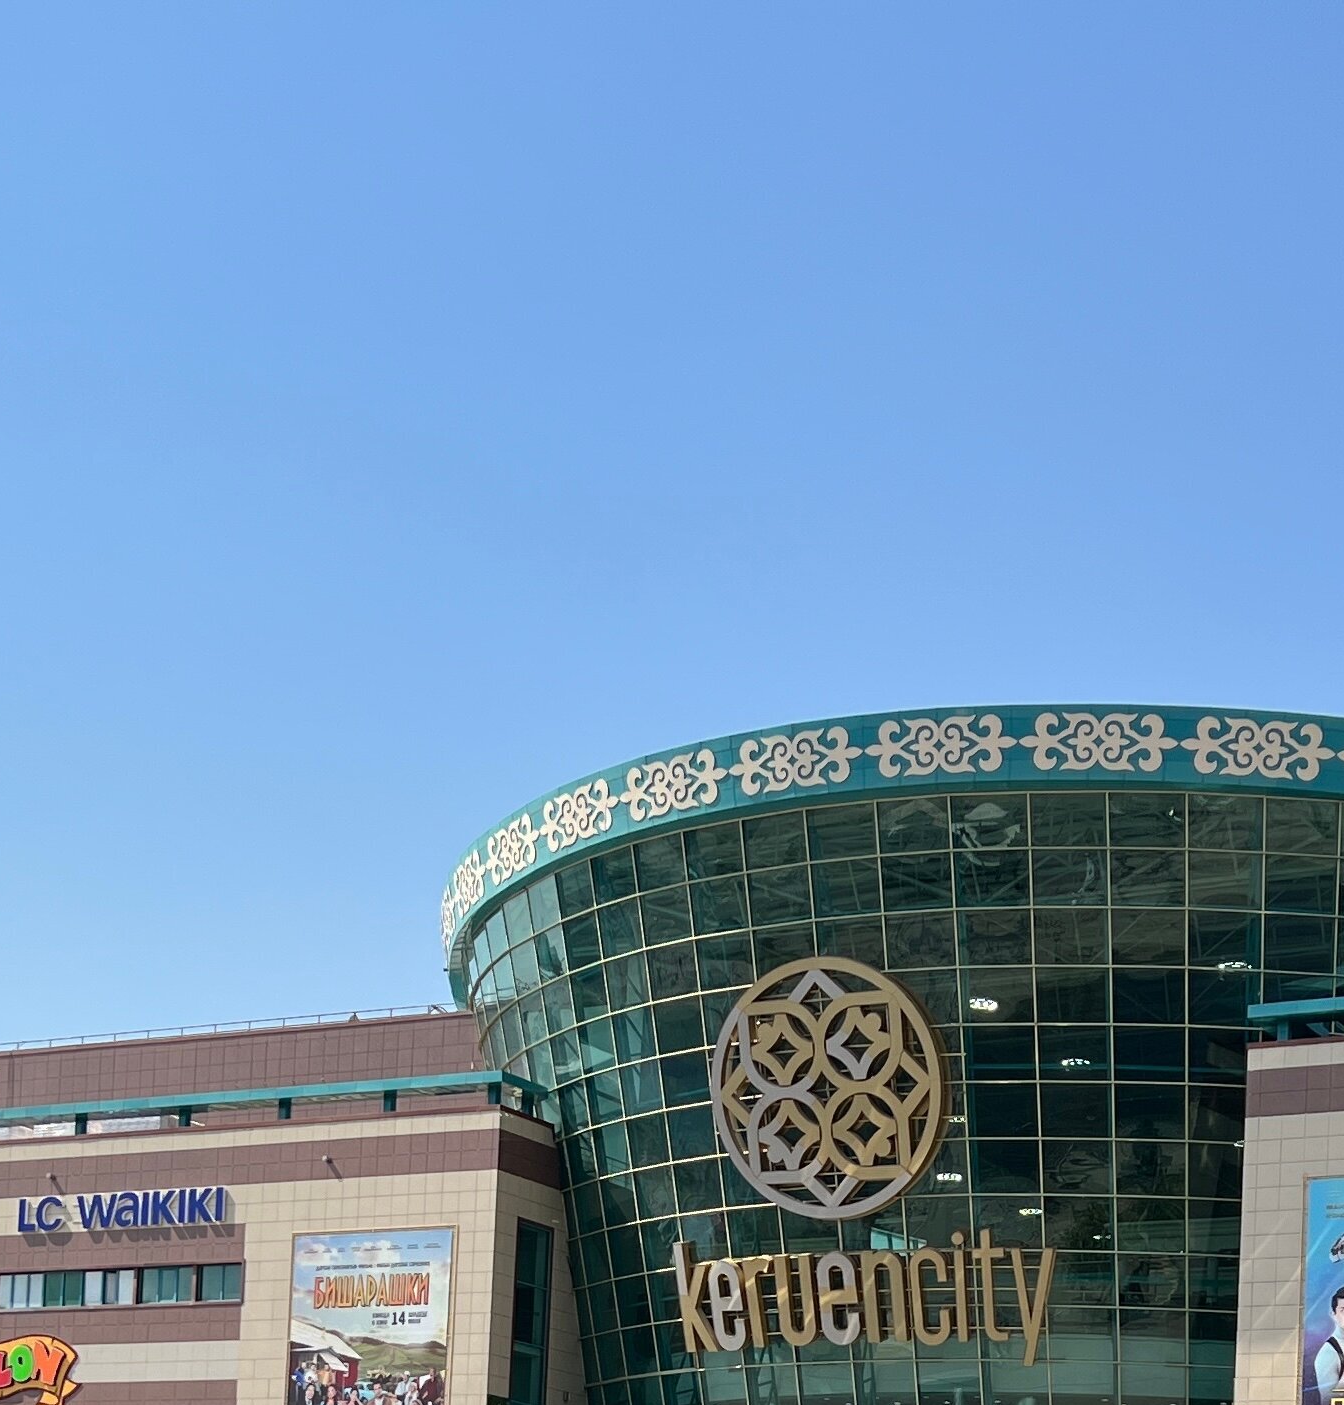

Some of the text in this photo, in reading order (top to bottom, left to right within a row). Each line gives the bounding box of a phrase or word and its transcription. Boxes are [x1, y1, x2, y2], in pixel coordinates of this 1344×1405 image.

[17, 1196, 62, 1233] LC
[314, 1272, 431, 1309] БИШАРАШКИ
[673, 1228, 1055, 1366] keruencity
[391, 1311, 406, 1326] 14
